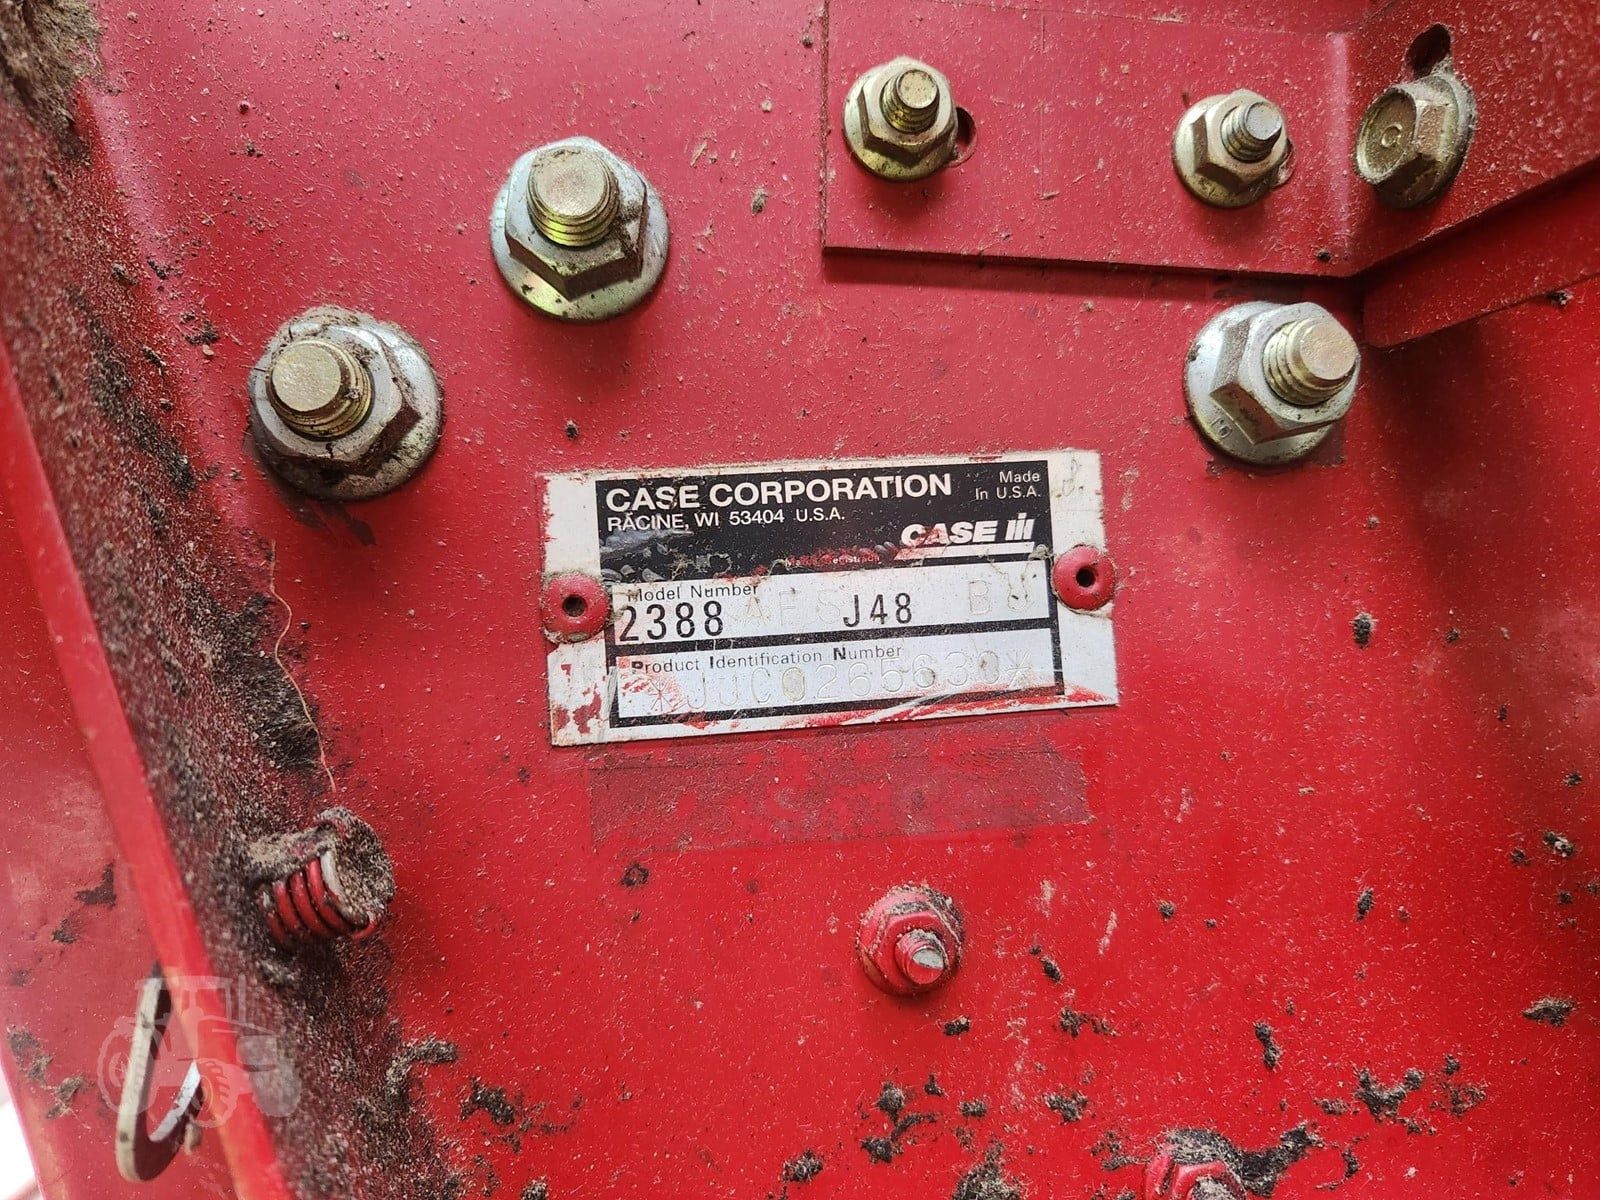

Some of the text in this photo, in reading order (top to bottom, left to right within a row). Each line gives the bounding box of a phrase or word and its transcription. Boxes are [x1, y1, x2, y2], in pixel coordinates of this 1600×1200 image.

[999, 470, 1041, 484] Made
[606, 473, 952, 512] CASE CORPORATION
[975, 485, 1041, 501] In U.S.A.
[607, 506, 845, 533] RACINE, WI 53404 U.S.A.
[901, 519, 998, 545] CASE
[691, 582, 758, 599] Number
[619, 600, 724, 642] 2388
[842, 592, 913, 629] J48
[631, 643, 903, 674] Product Identification Number
